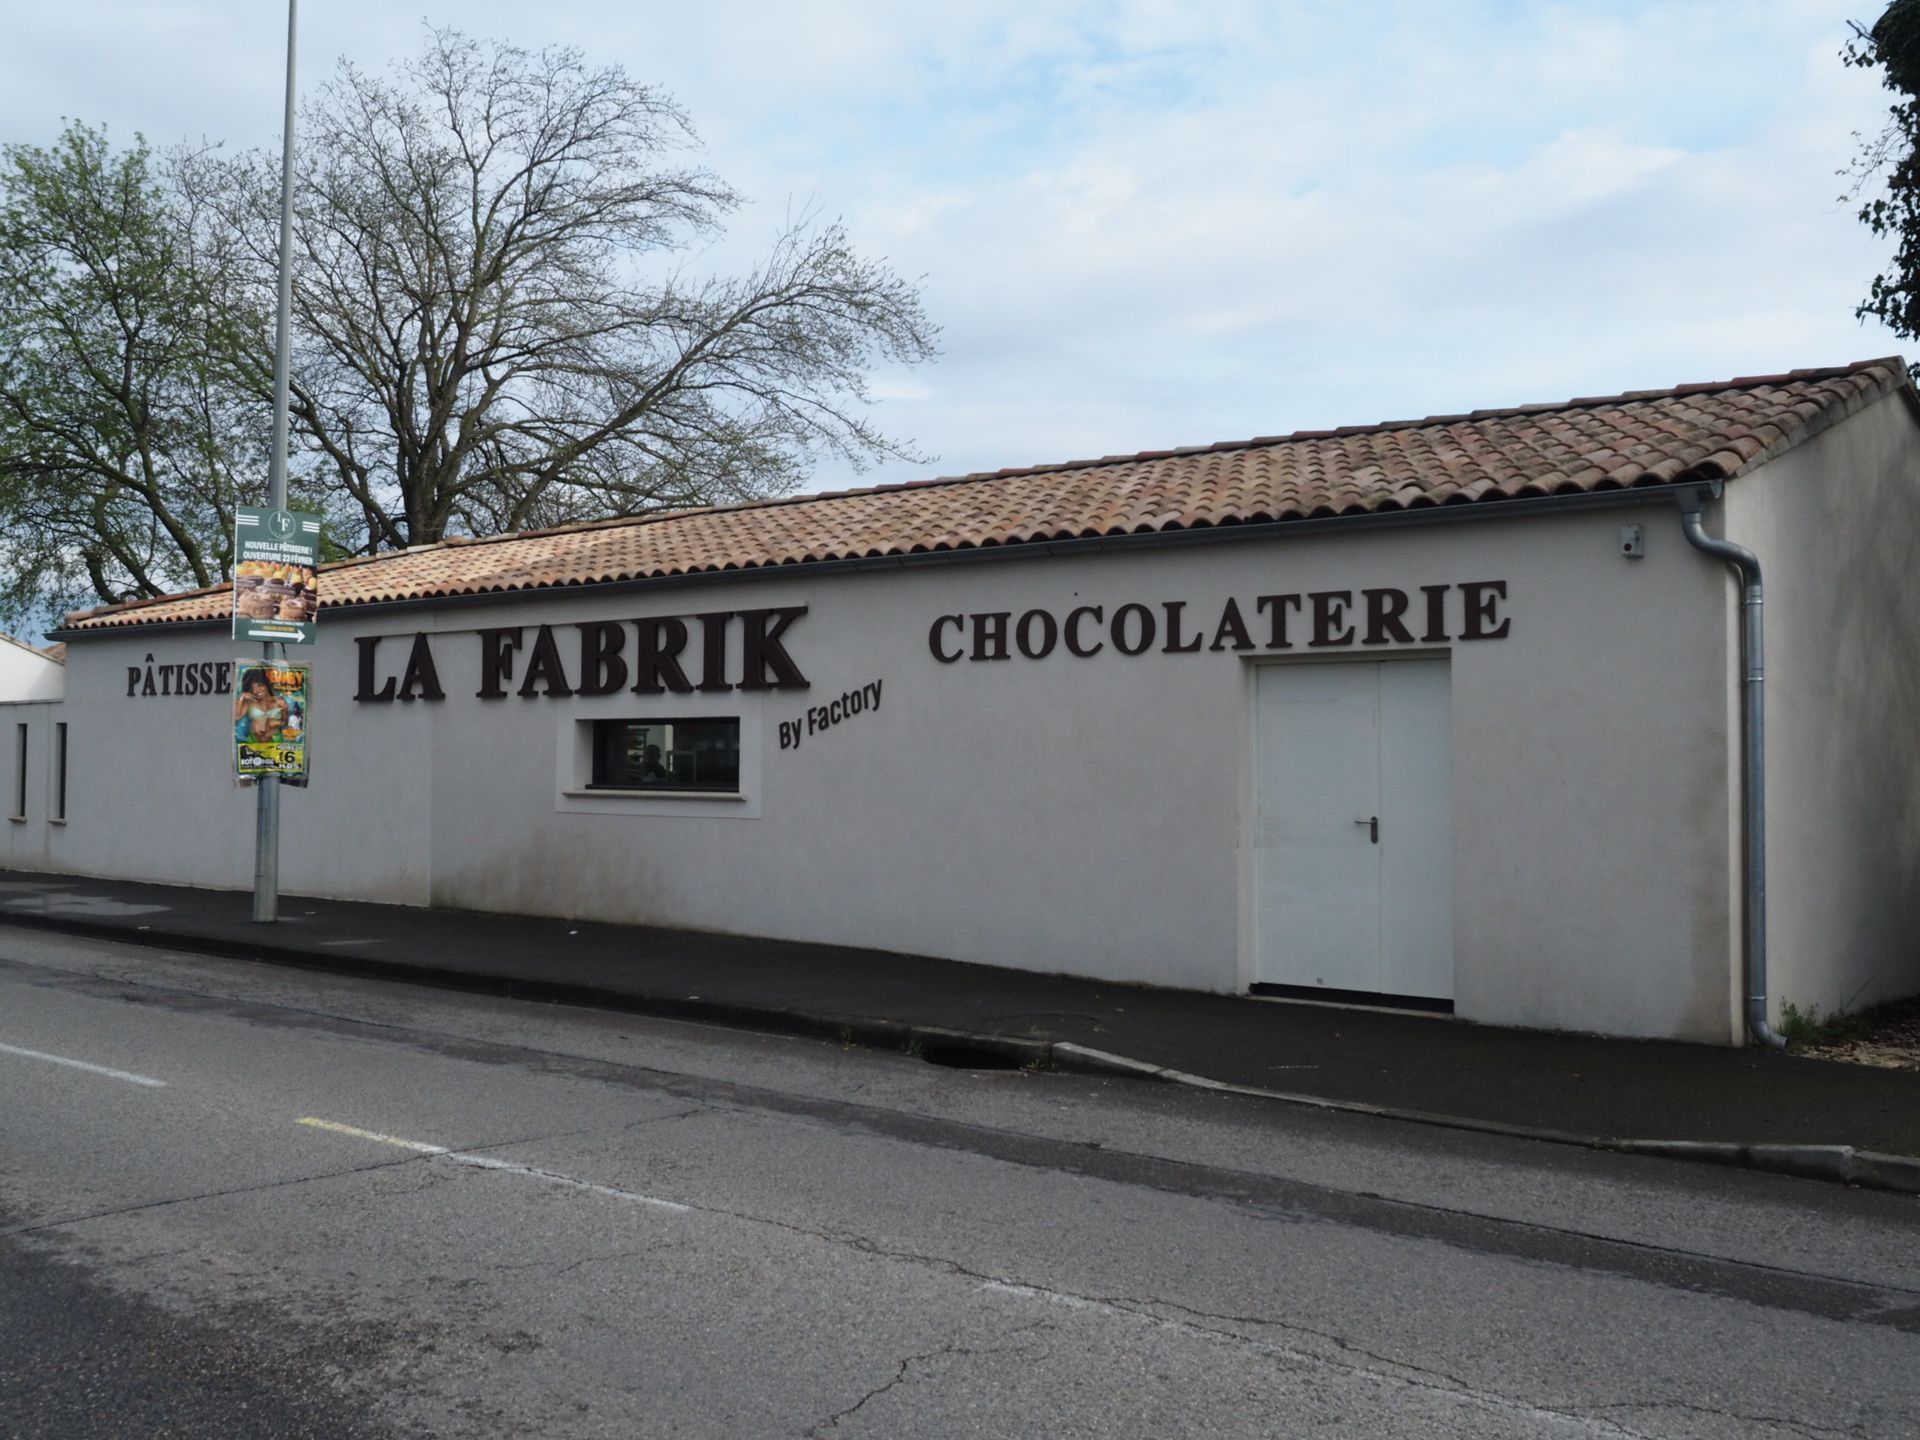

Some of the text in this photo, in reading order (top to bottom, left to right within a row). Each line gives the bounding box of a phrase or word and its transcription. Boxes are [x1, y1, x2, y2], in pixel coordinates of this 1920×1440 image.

[243, 551, 283, 562] OUVERTURE
[245, 541, 279, 551] NOUVELLE
[928, 580, 1512, 665] CHOCOLATERIE
[127, 653, 236, 697] PÂTISSE
[353, 606, 811, 701] LA FABRIK
[778, 678, 883, 750] By Factory
